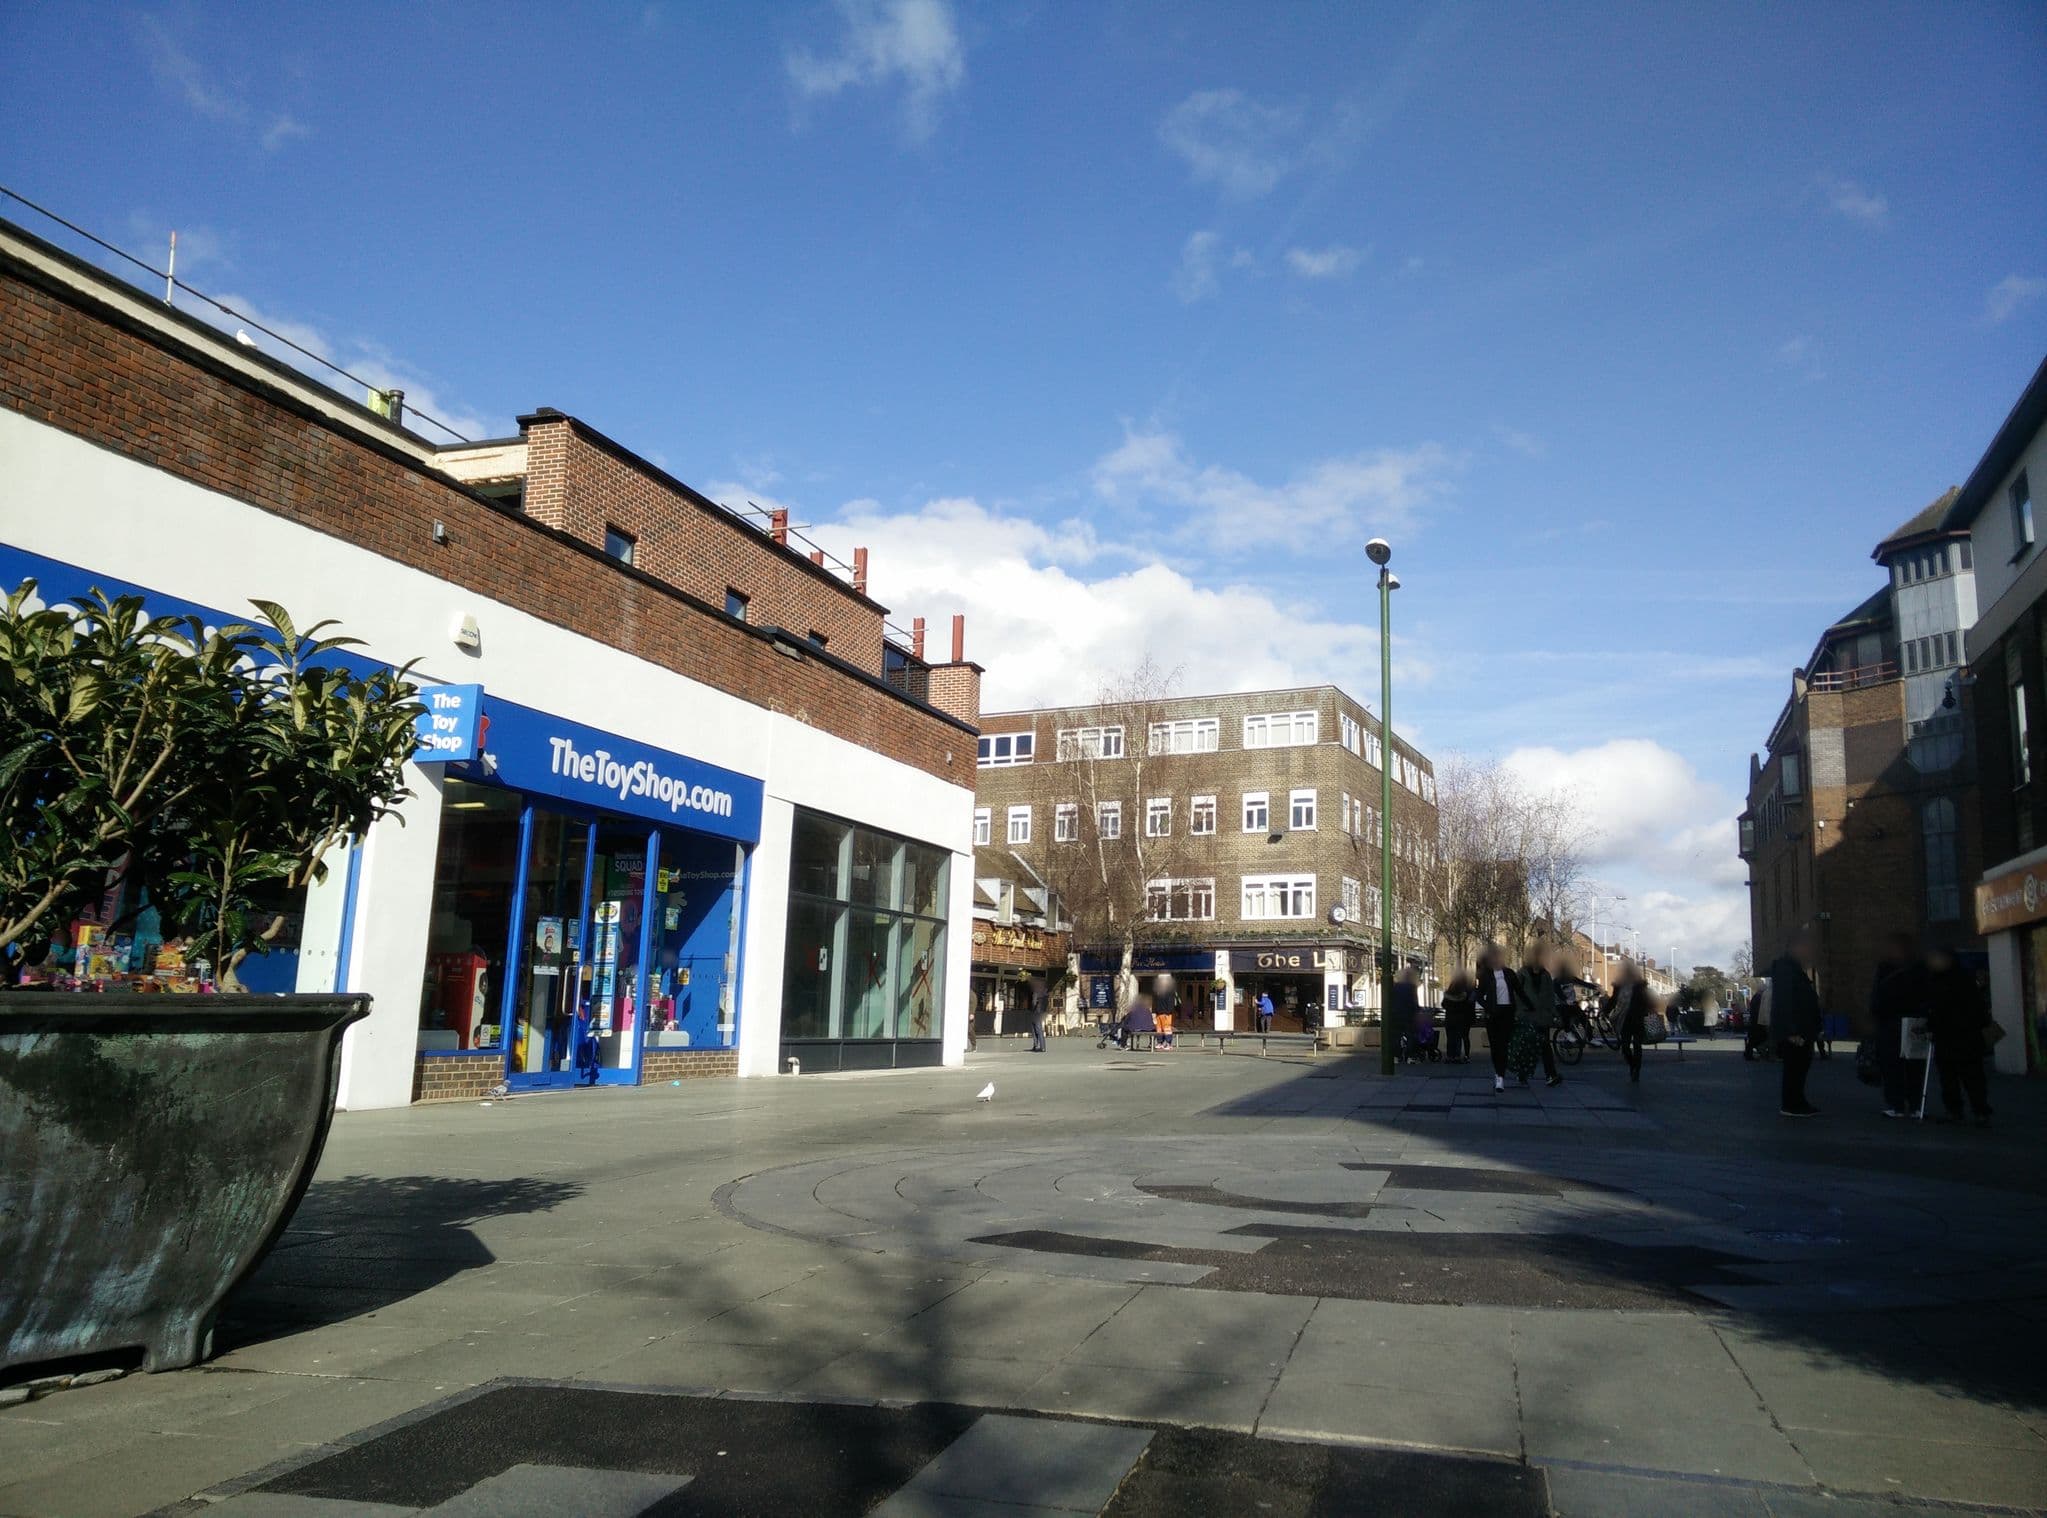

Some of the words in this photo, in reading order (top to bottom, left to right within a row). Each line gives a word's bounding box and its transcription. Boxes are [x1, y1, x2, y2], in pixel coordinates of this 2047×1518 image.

[432, 692, 462, 709] The
[431, 714, 458, 733] Toy
[421, 733, 462, 752] Shop
[549, 736, 733, 818] TheToyShop.com
[614, 860, 643, 872] SQUAD
[1257, 952, 1301, 968] The
